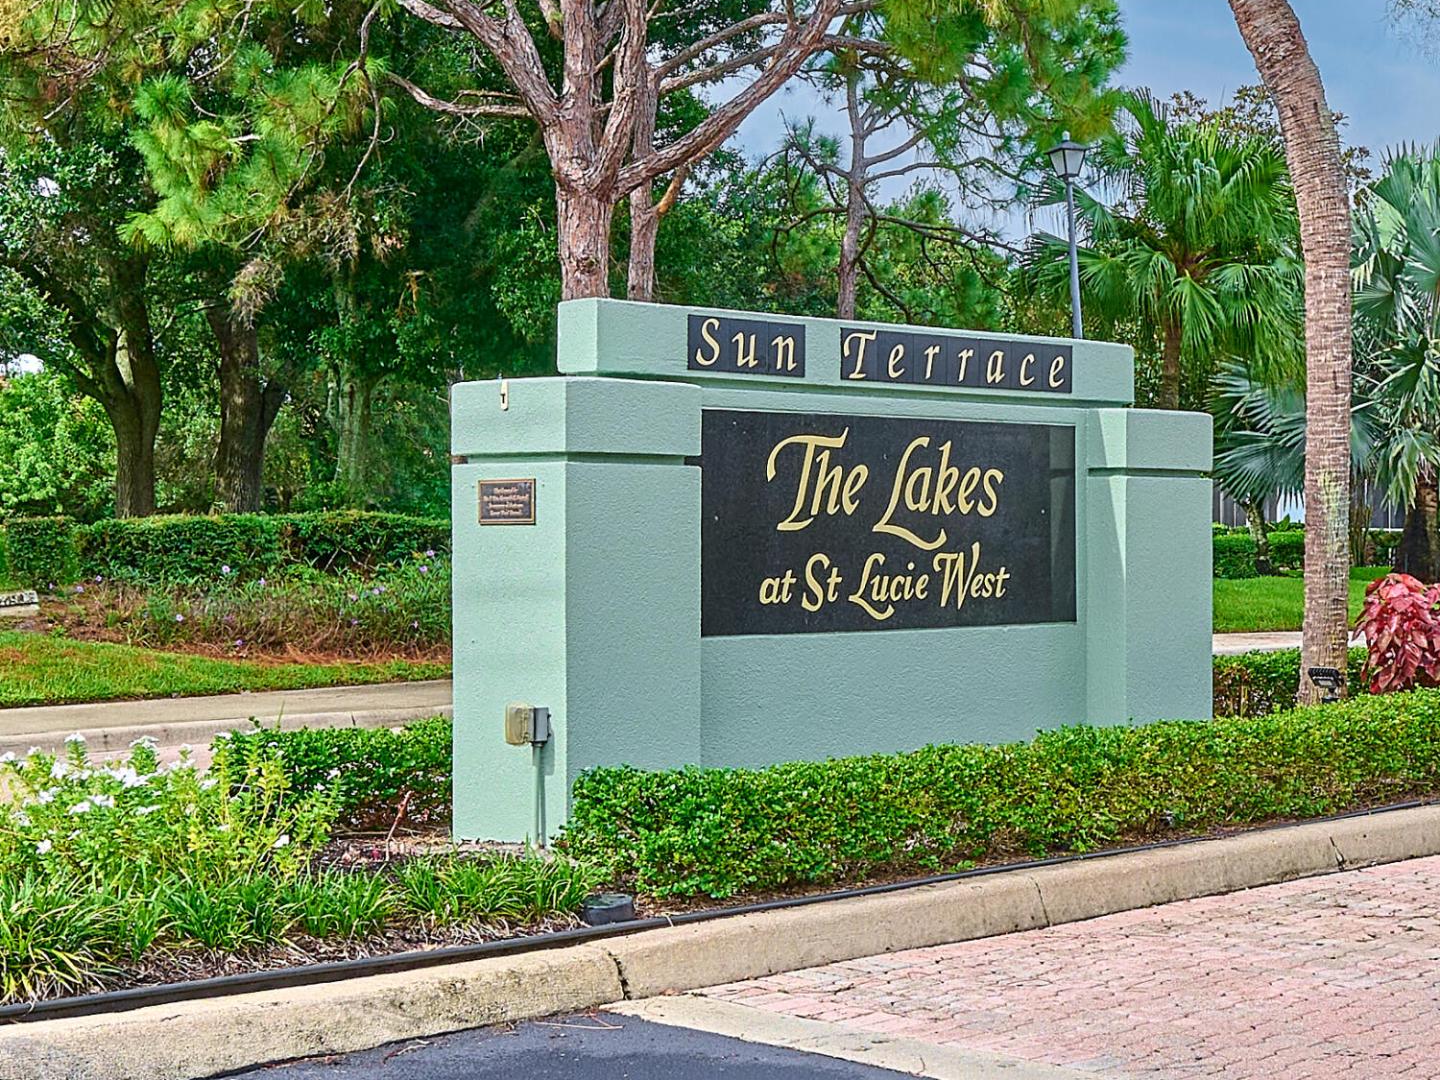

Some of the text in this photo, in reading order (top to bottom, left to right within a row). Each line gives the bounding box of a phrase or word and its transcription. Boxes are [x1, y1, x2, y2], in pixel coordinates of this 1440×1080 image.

[695, 317, 1066, 389] Sun Terrace
[766, 426, 1005, 551] The Lakes
[759, 541, 1011, 621] at St Lucie West
